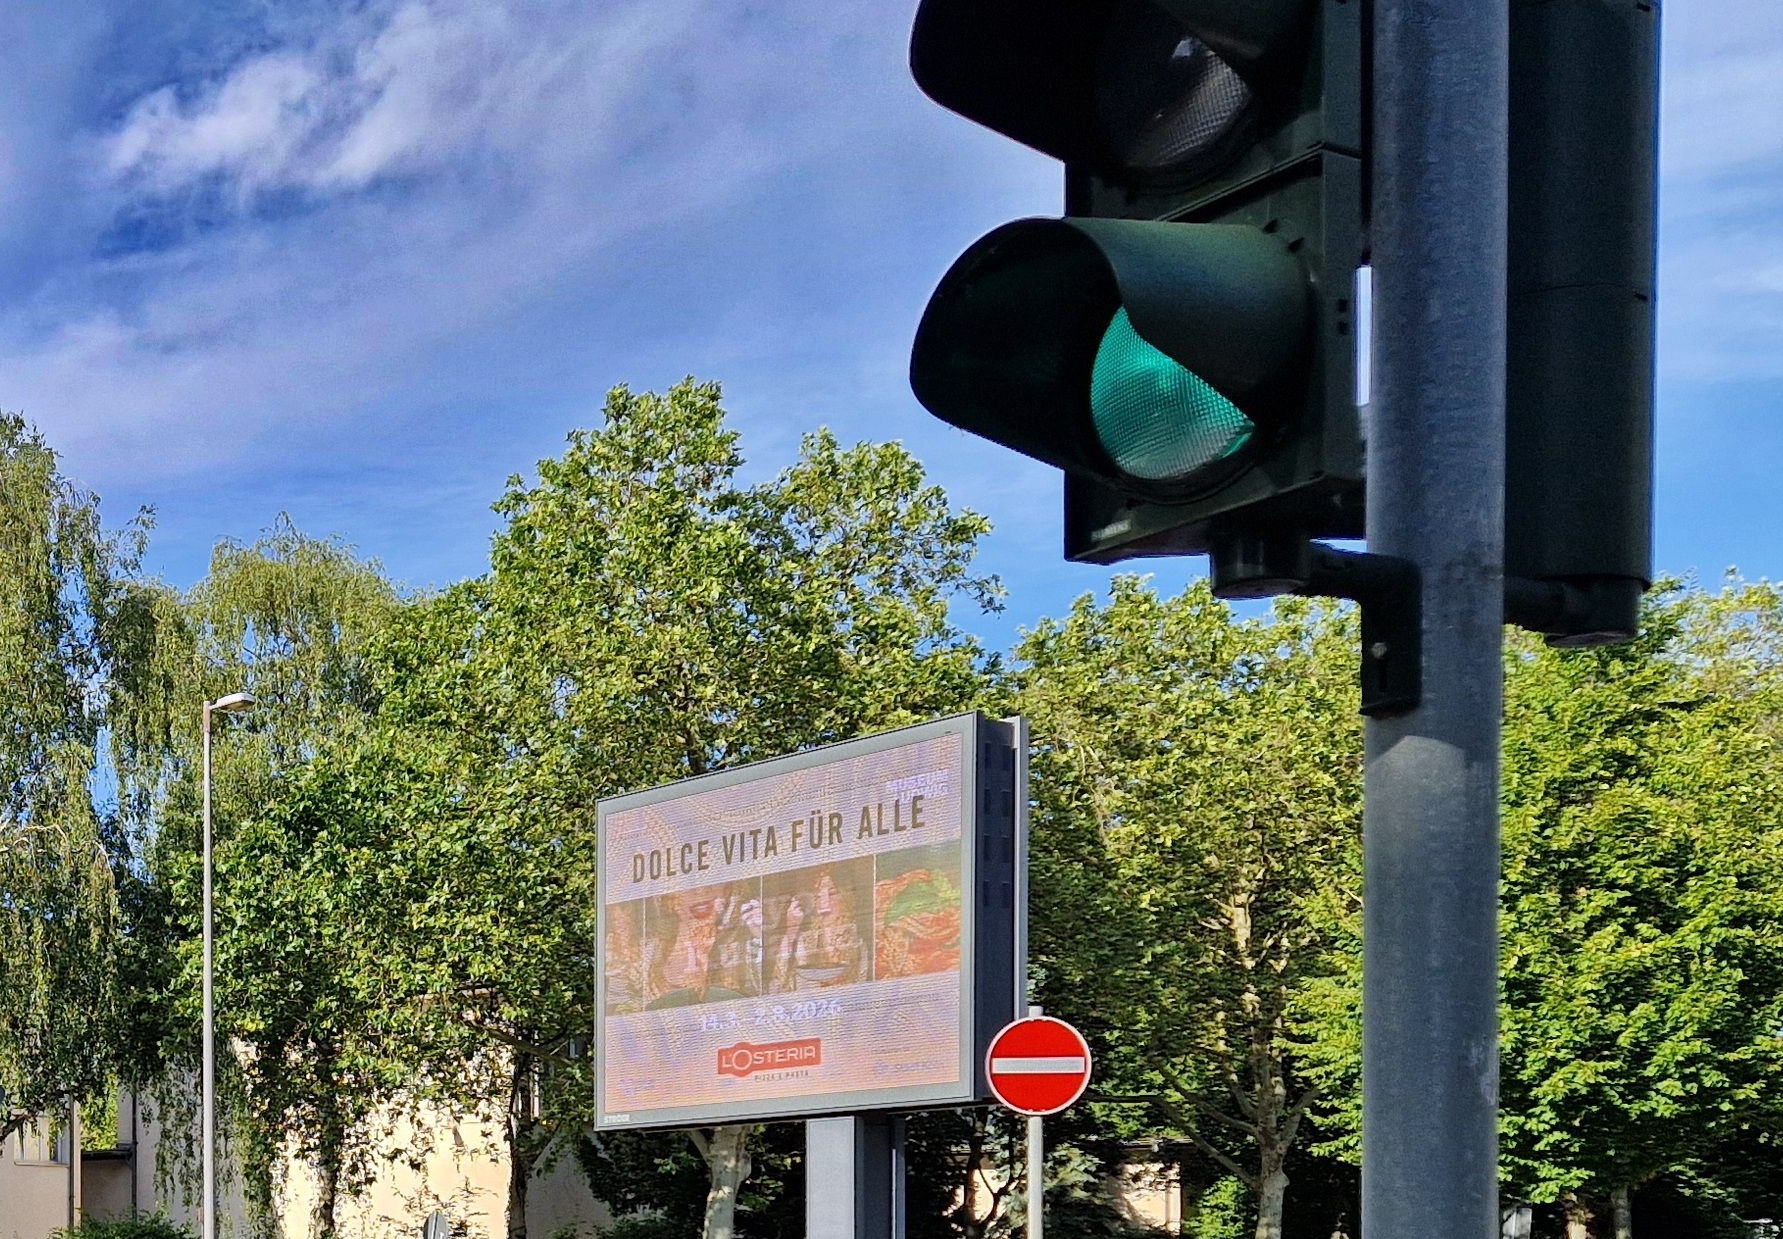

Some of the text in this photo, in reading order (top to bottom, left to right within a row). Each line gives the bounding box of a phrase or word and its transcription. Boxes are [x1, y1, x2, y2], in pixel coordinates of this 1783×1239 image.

[632, 794, 926, 883] DOLCE VITA FÜR ALLE
[722, 1046, 816, 1071] L'OSTERIA
